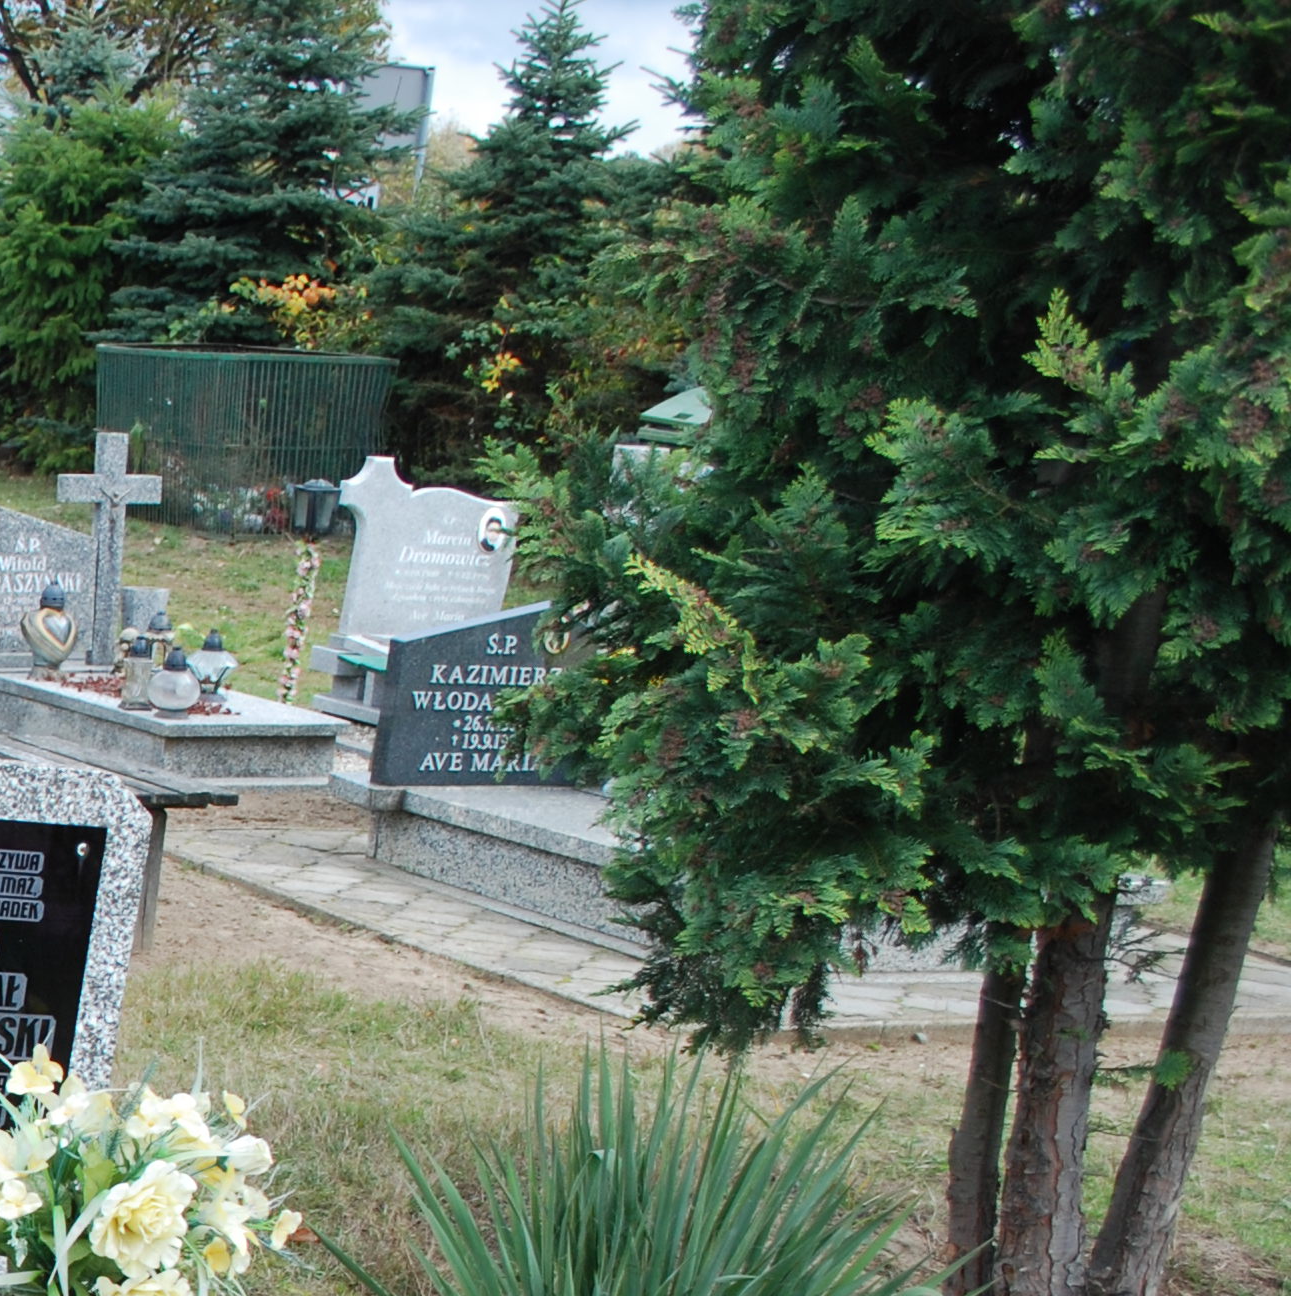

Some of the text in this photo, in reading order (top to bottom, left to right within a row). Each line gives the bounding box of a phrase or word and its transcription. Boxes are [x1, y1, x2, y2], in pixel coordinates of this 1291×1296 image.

[423, 530, 472, 546] Marcin
[399, 545, 491, 567] Dromowicz
[419, 752, 463, 771] AVE
